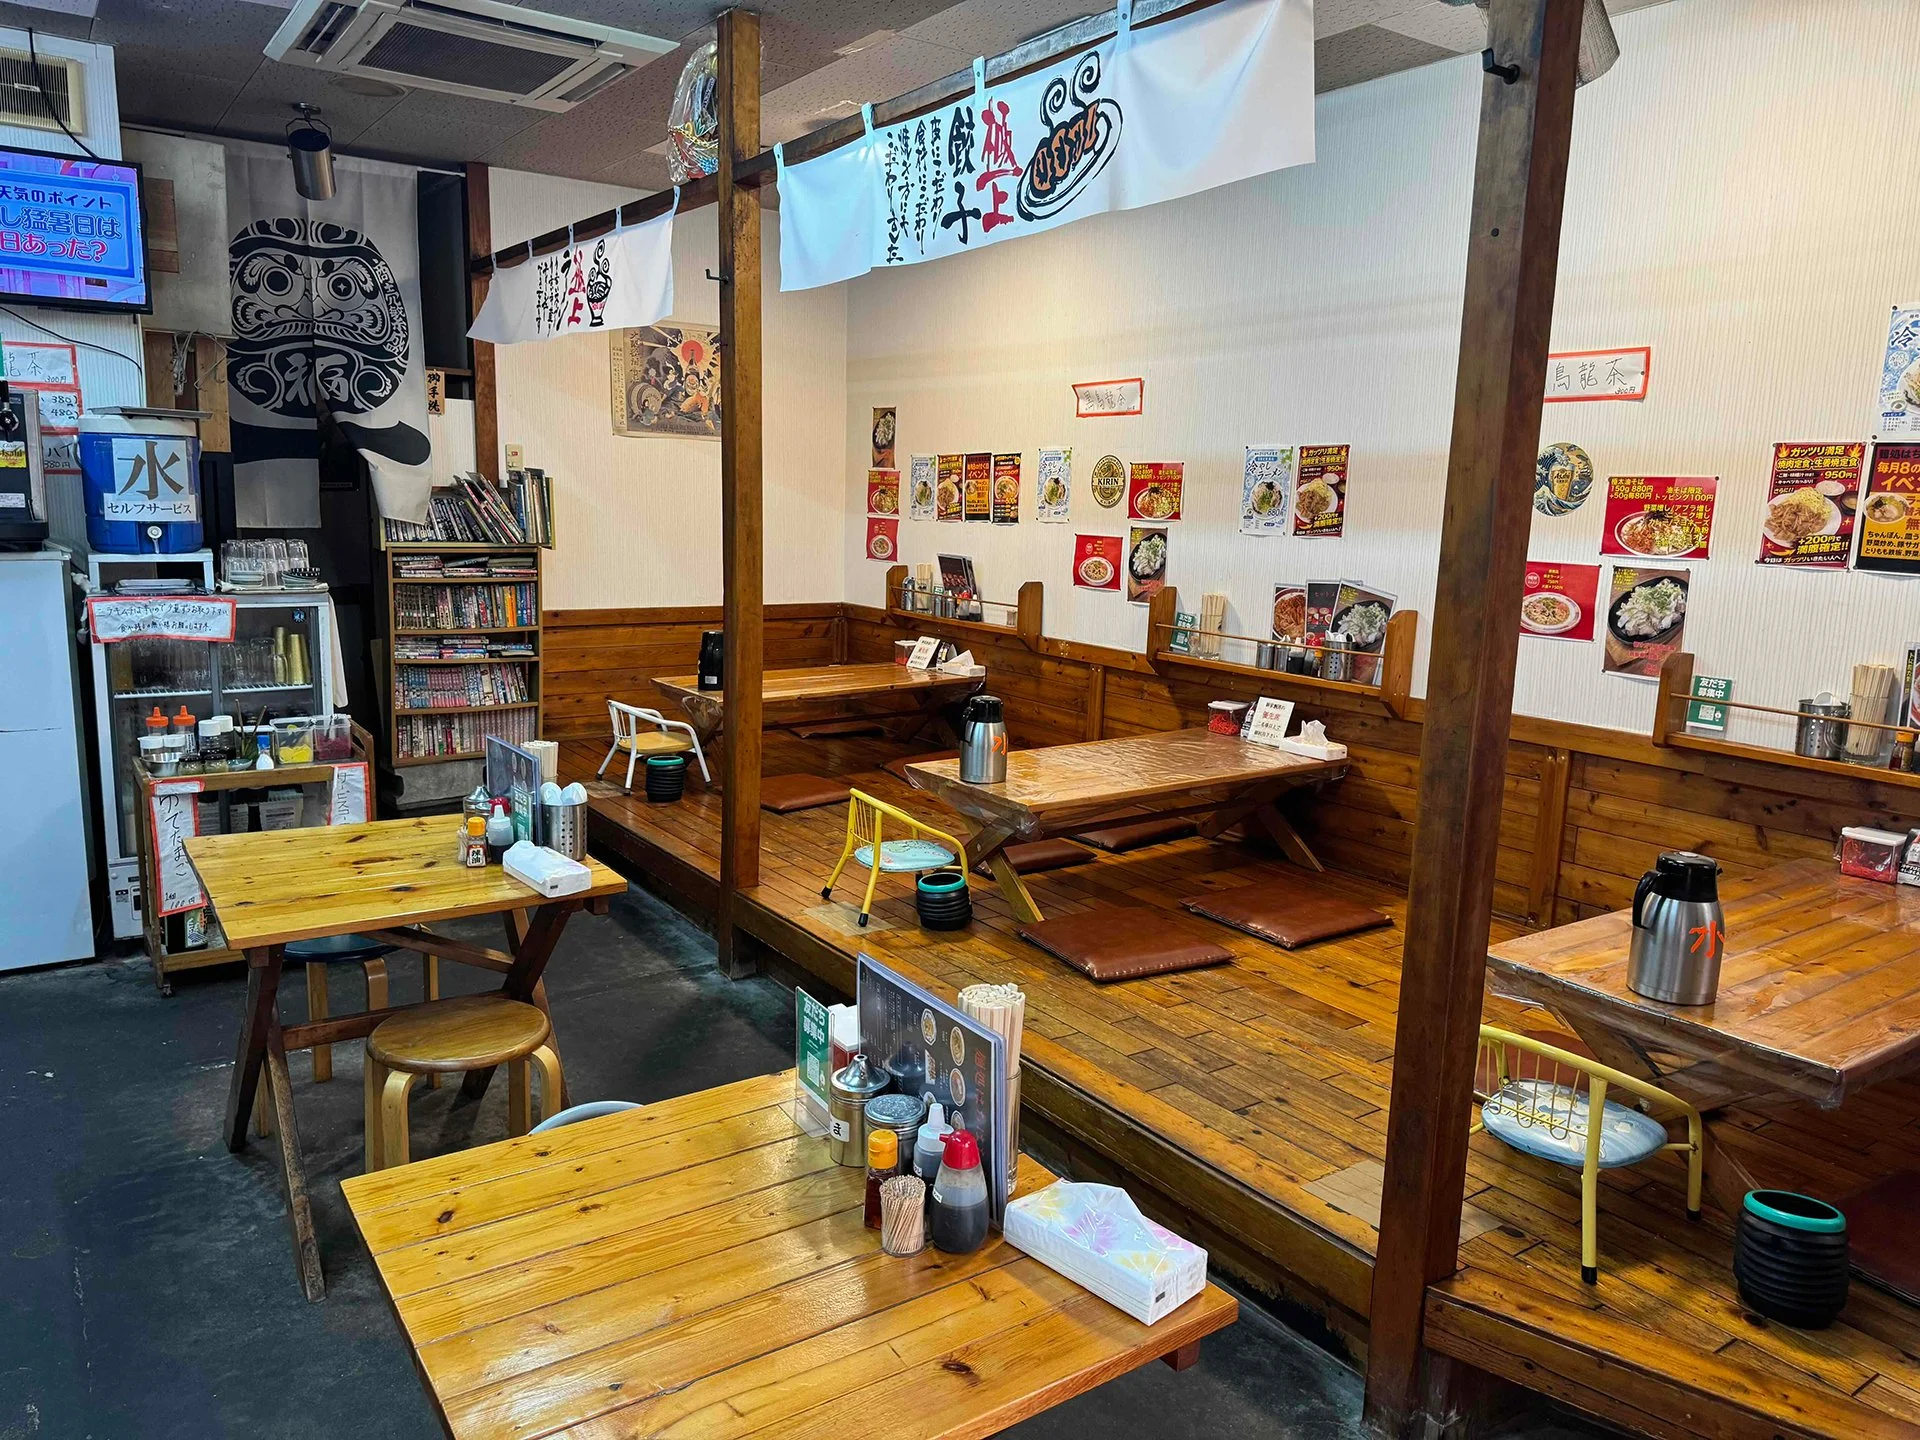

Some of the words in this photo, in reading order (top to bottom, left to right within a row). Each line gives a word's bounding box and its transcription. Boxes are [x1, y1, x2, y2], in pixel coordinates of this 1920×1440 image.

[941, 106, 981, 245] 餃子
[427, 371, 442, 413] 御手洗
[1790, 446, 1845, 457] ガッツリ満足
[117, 440, 185, 500] 水
[1824, 471, 1852, 479] 950円
[1881, 475, 1920, 491] イベ
[107, 502, 192, 516] セルフサービス
[1698, 688, 1725, 699] 募集中
[1699, 678, 1727, 689] 友だち
[337, 772, 354, 824] サービスコー
[159, 794, 189, 877] ゆでたまご
[803, 996, 826, 1025] 友だち
